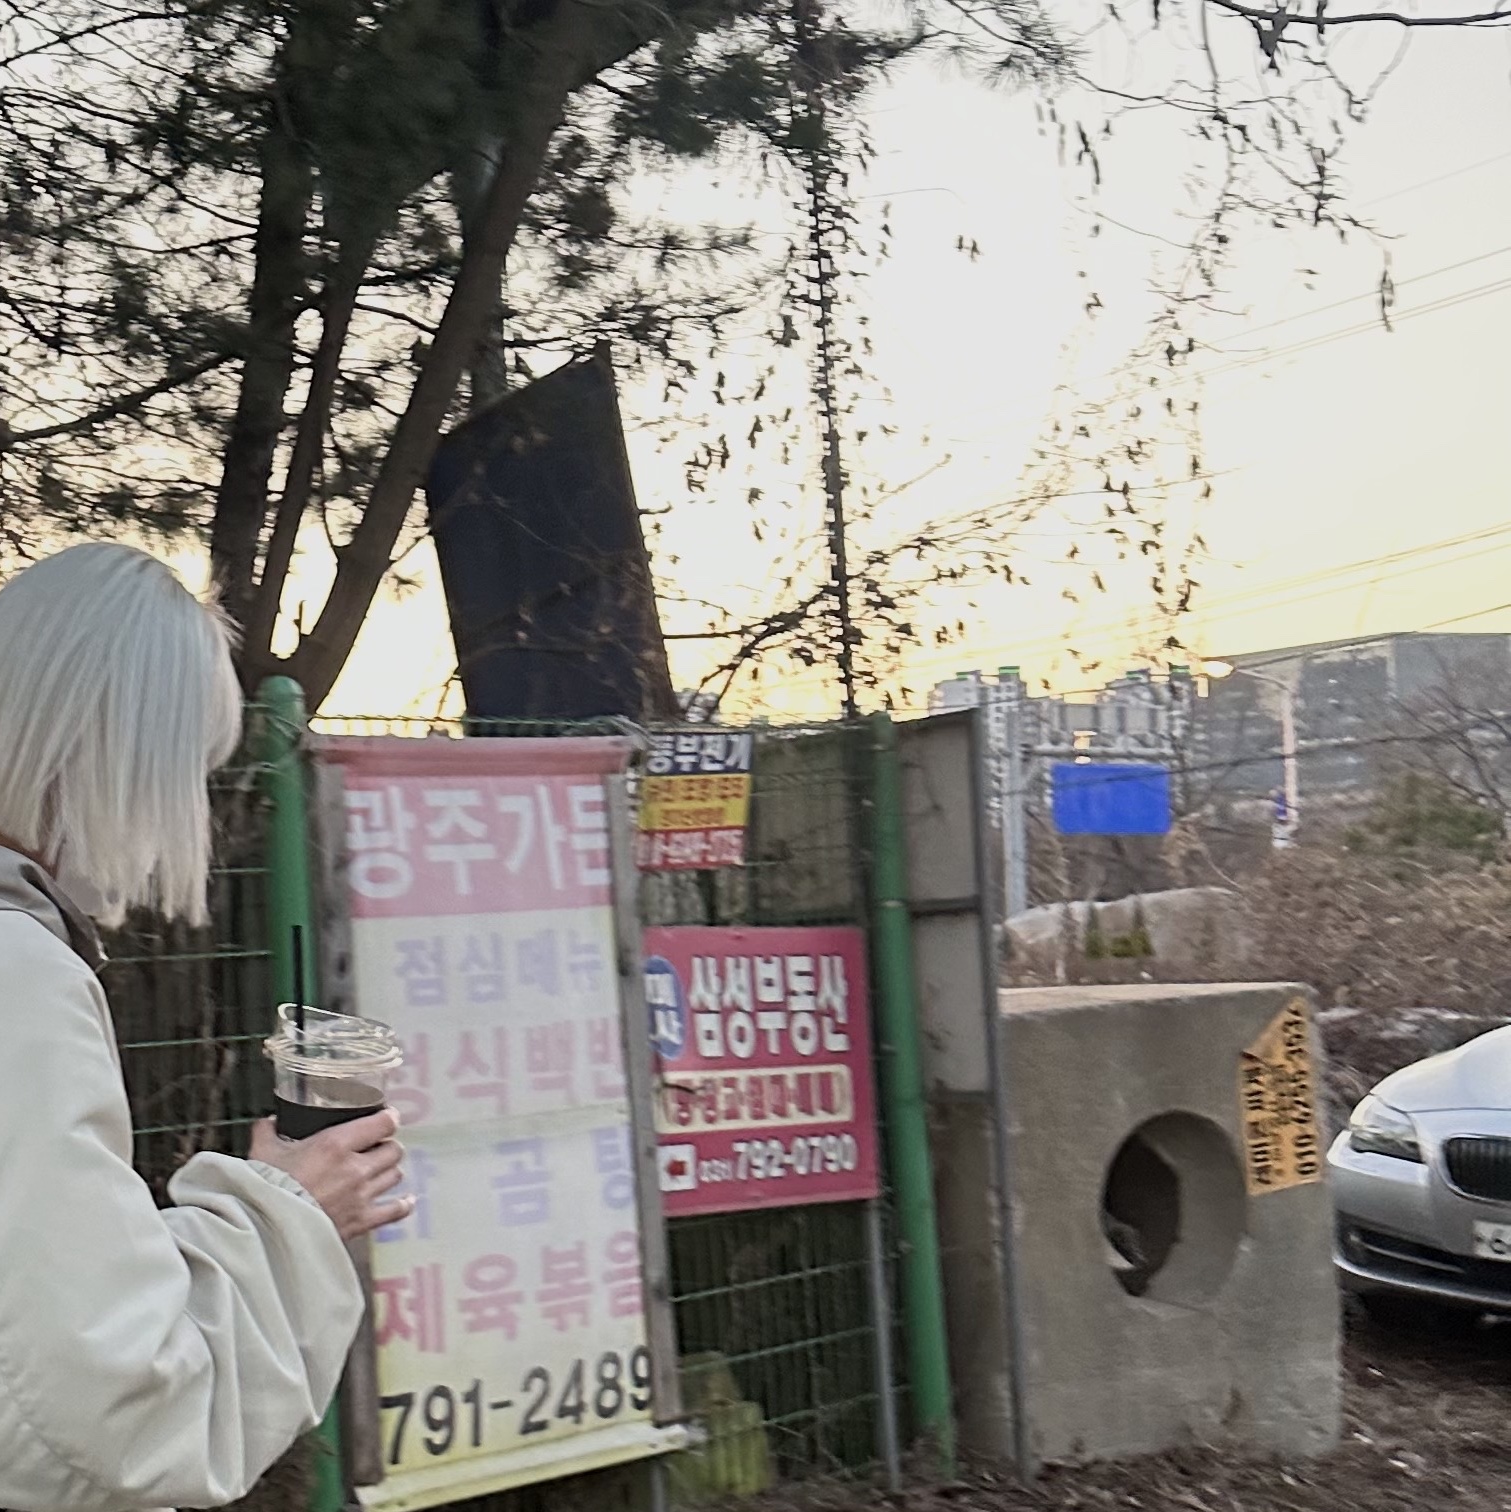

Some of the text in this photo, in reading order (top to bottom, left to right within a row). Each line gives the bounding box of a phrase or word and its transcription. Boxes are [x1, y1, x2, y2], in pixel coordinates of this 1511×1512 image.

[344, 784, 611, 900] 광주가든
[689, 954, 851, 1060] 삼성부동산
[378, 1344, 653, 1466] 791-2489
